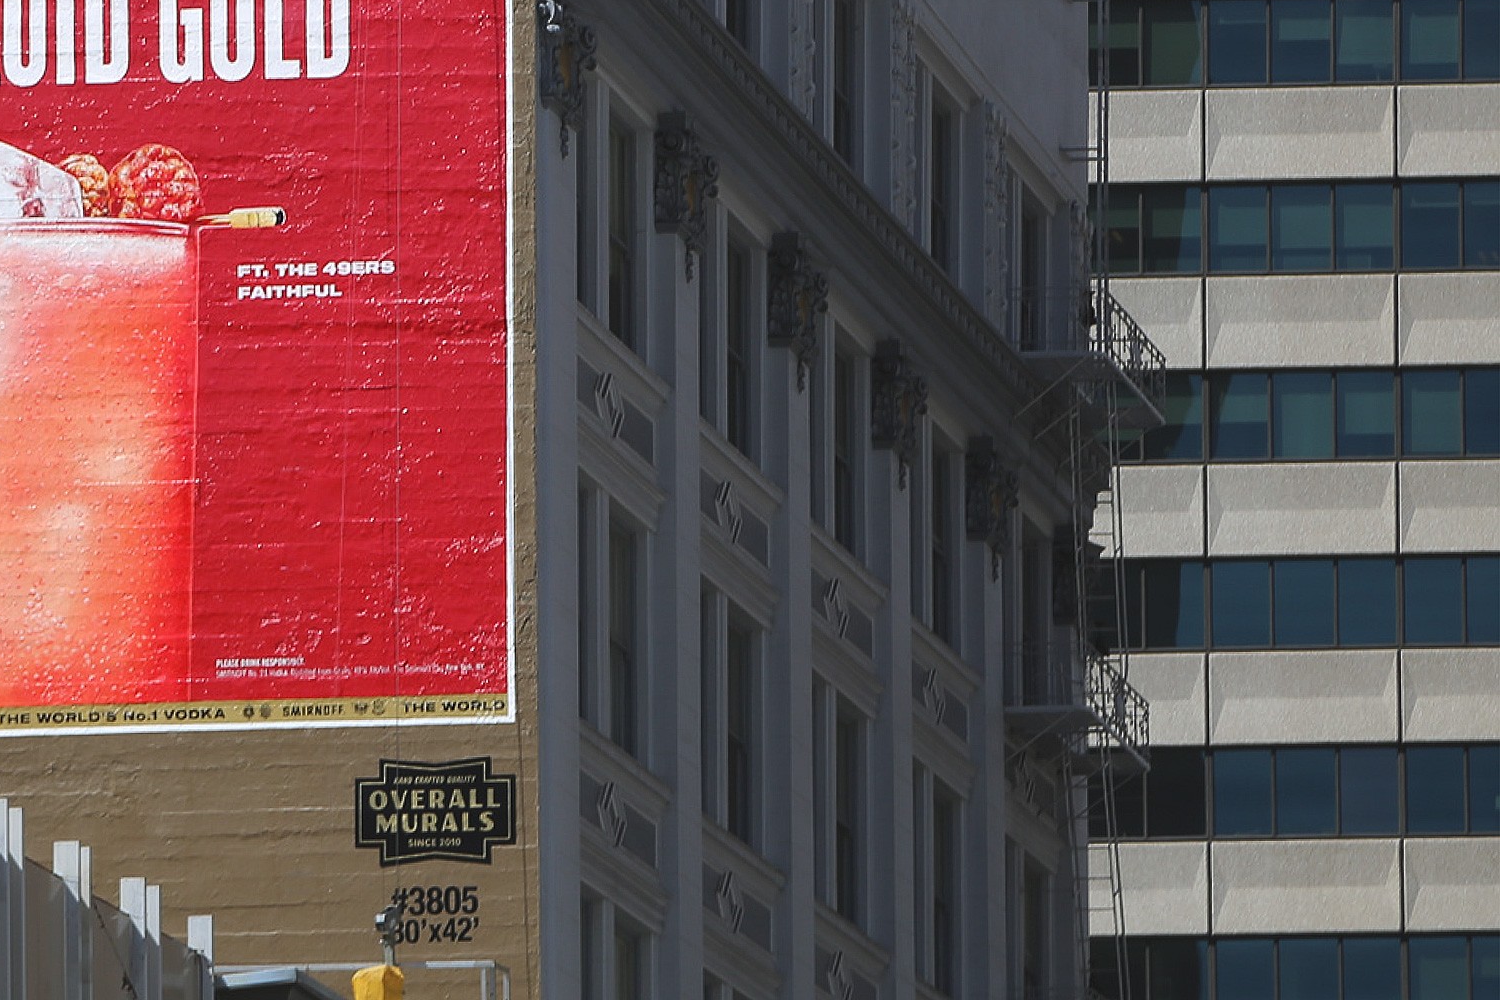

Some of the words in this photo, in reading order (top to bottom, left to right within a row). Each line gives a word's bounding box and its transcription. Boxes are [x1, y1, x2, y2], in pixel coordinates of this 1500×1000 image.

[237, 263, 270, 279] FT.
[275, 262, 318, 277] THE
[322, 260, 395, 276] 49ERS
[237, 283, 343, 300] FAITHFUL
[37, 711, 115, 724] WORLD'S
[164, 707, 226, 720] VODKA
[403, 700, 436, 713] THE
[441, 699, 505, 712] WORLD
[368, 788, 501, 811] OVERALL
[375, 810, 495, 834] MURALS
[408, 838, 436, 848] SINCE
[439, 837, 462, 847] 2010
[391, 886, 479, 916] #3805
